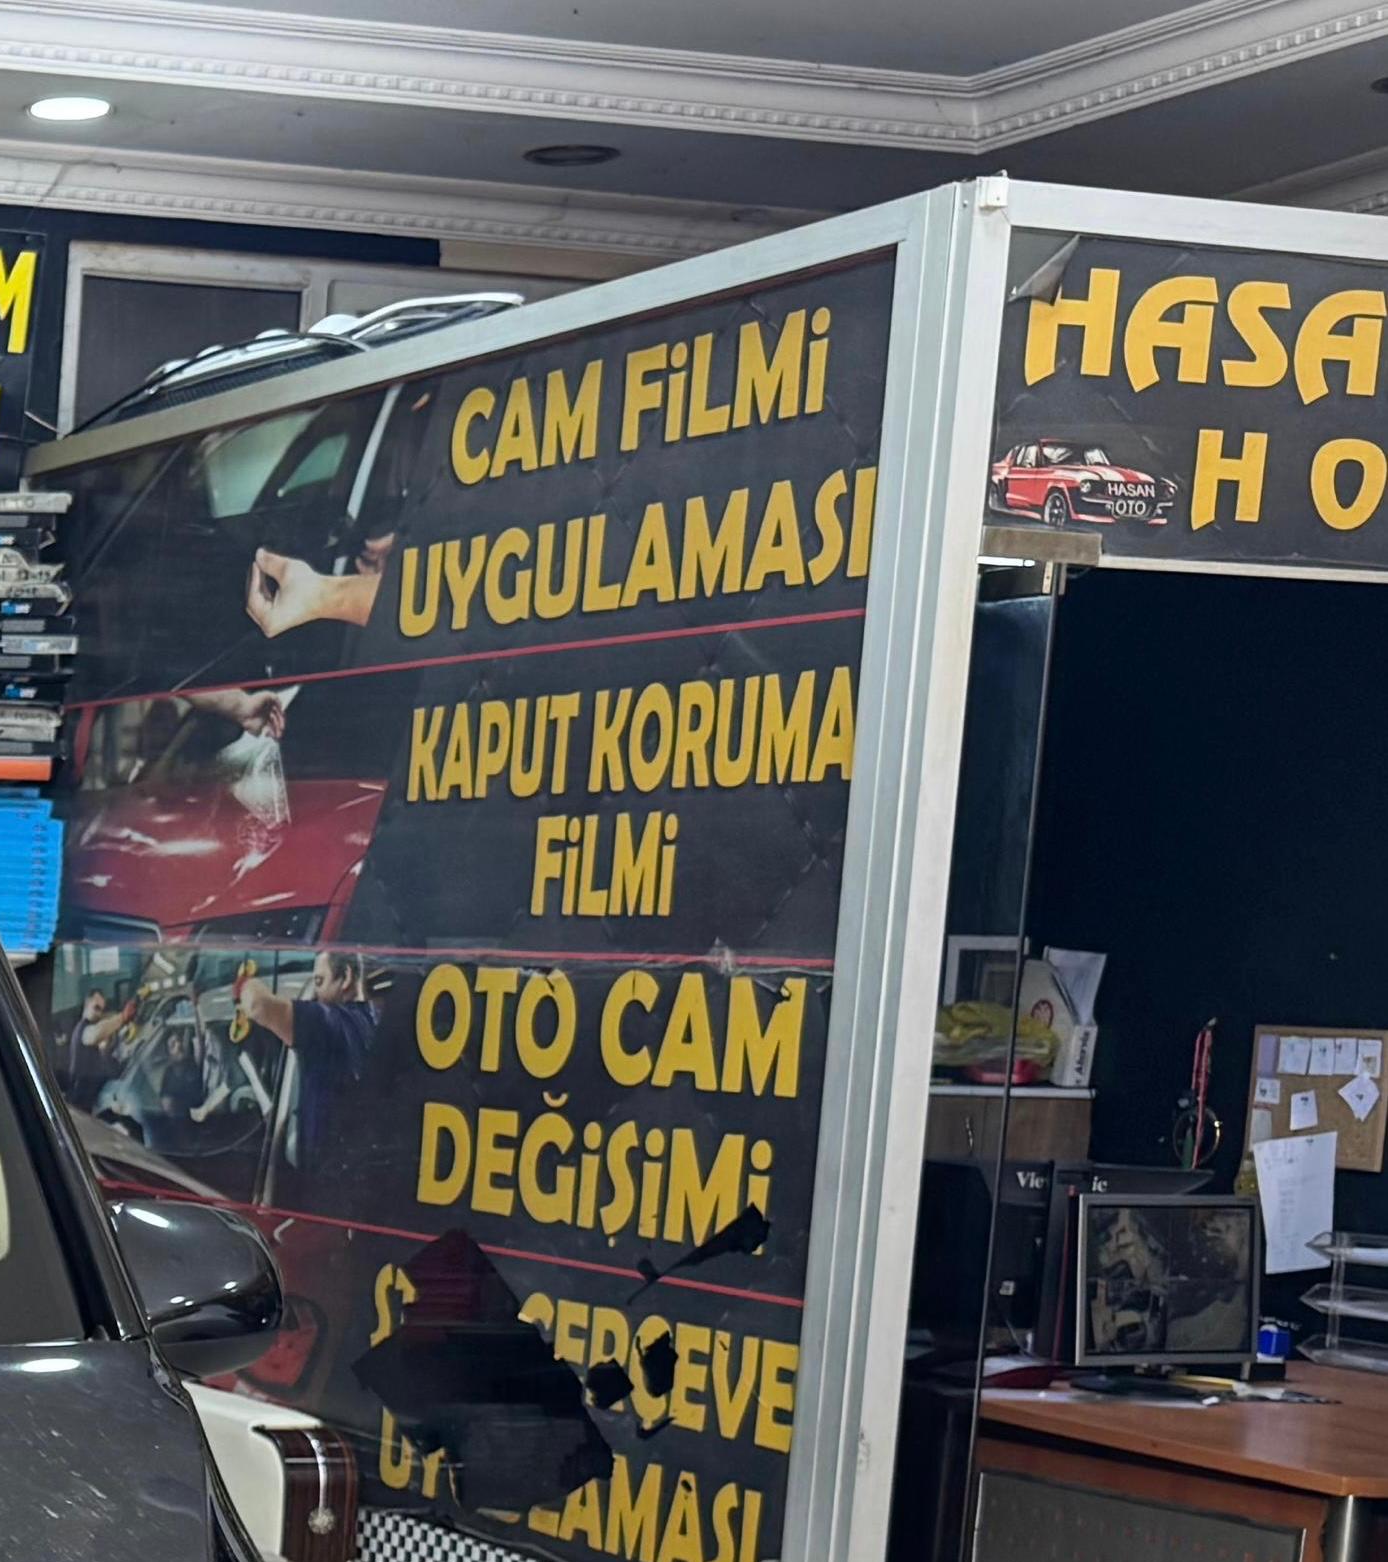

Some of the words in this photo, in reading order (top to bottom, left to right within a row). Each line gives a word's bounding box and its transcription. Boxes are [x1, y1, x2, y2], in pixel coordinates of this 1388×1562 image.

[450, 358, 603, 487] CAM
[397, 467, 878, 639] UYGULAMASI
[1106, 480, 1156, 499] HASAN
[1113, 499, 1148, 517] OTO
[406, 690, 583, 803] KAPUT
[588, 667, 855, 793] KORUMA
[416, 963, 578, 1080] OTO
[600, 968, 808, 1099] CAM
